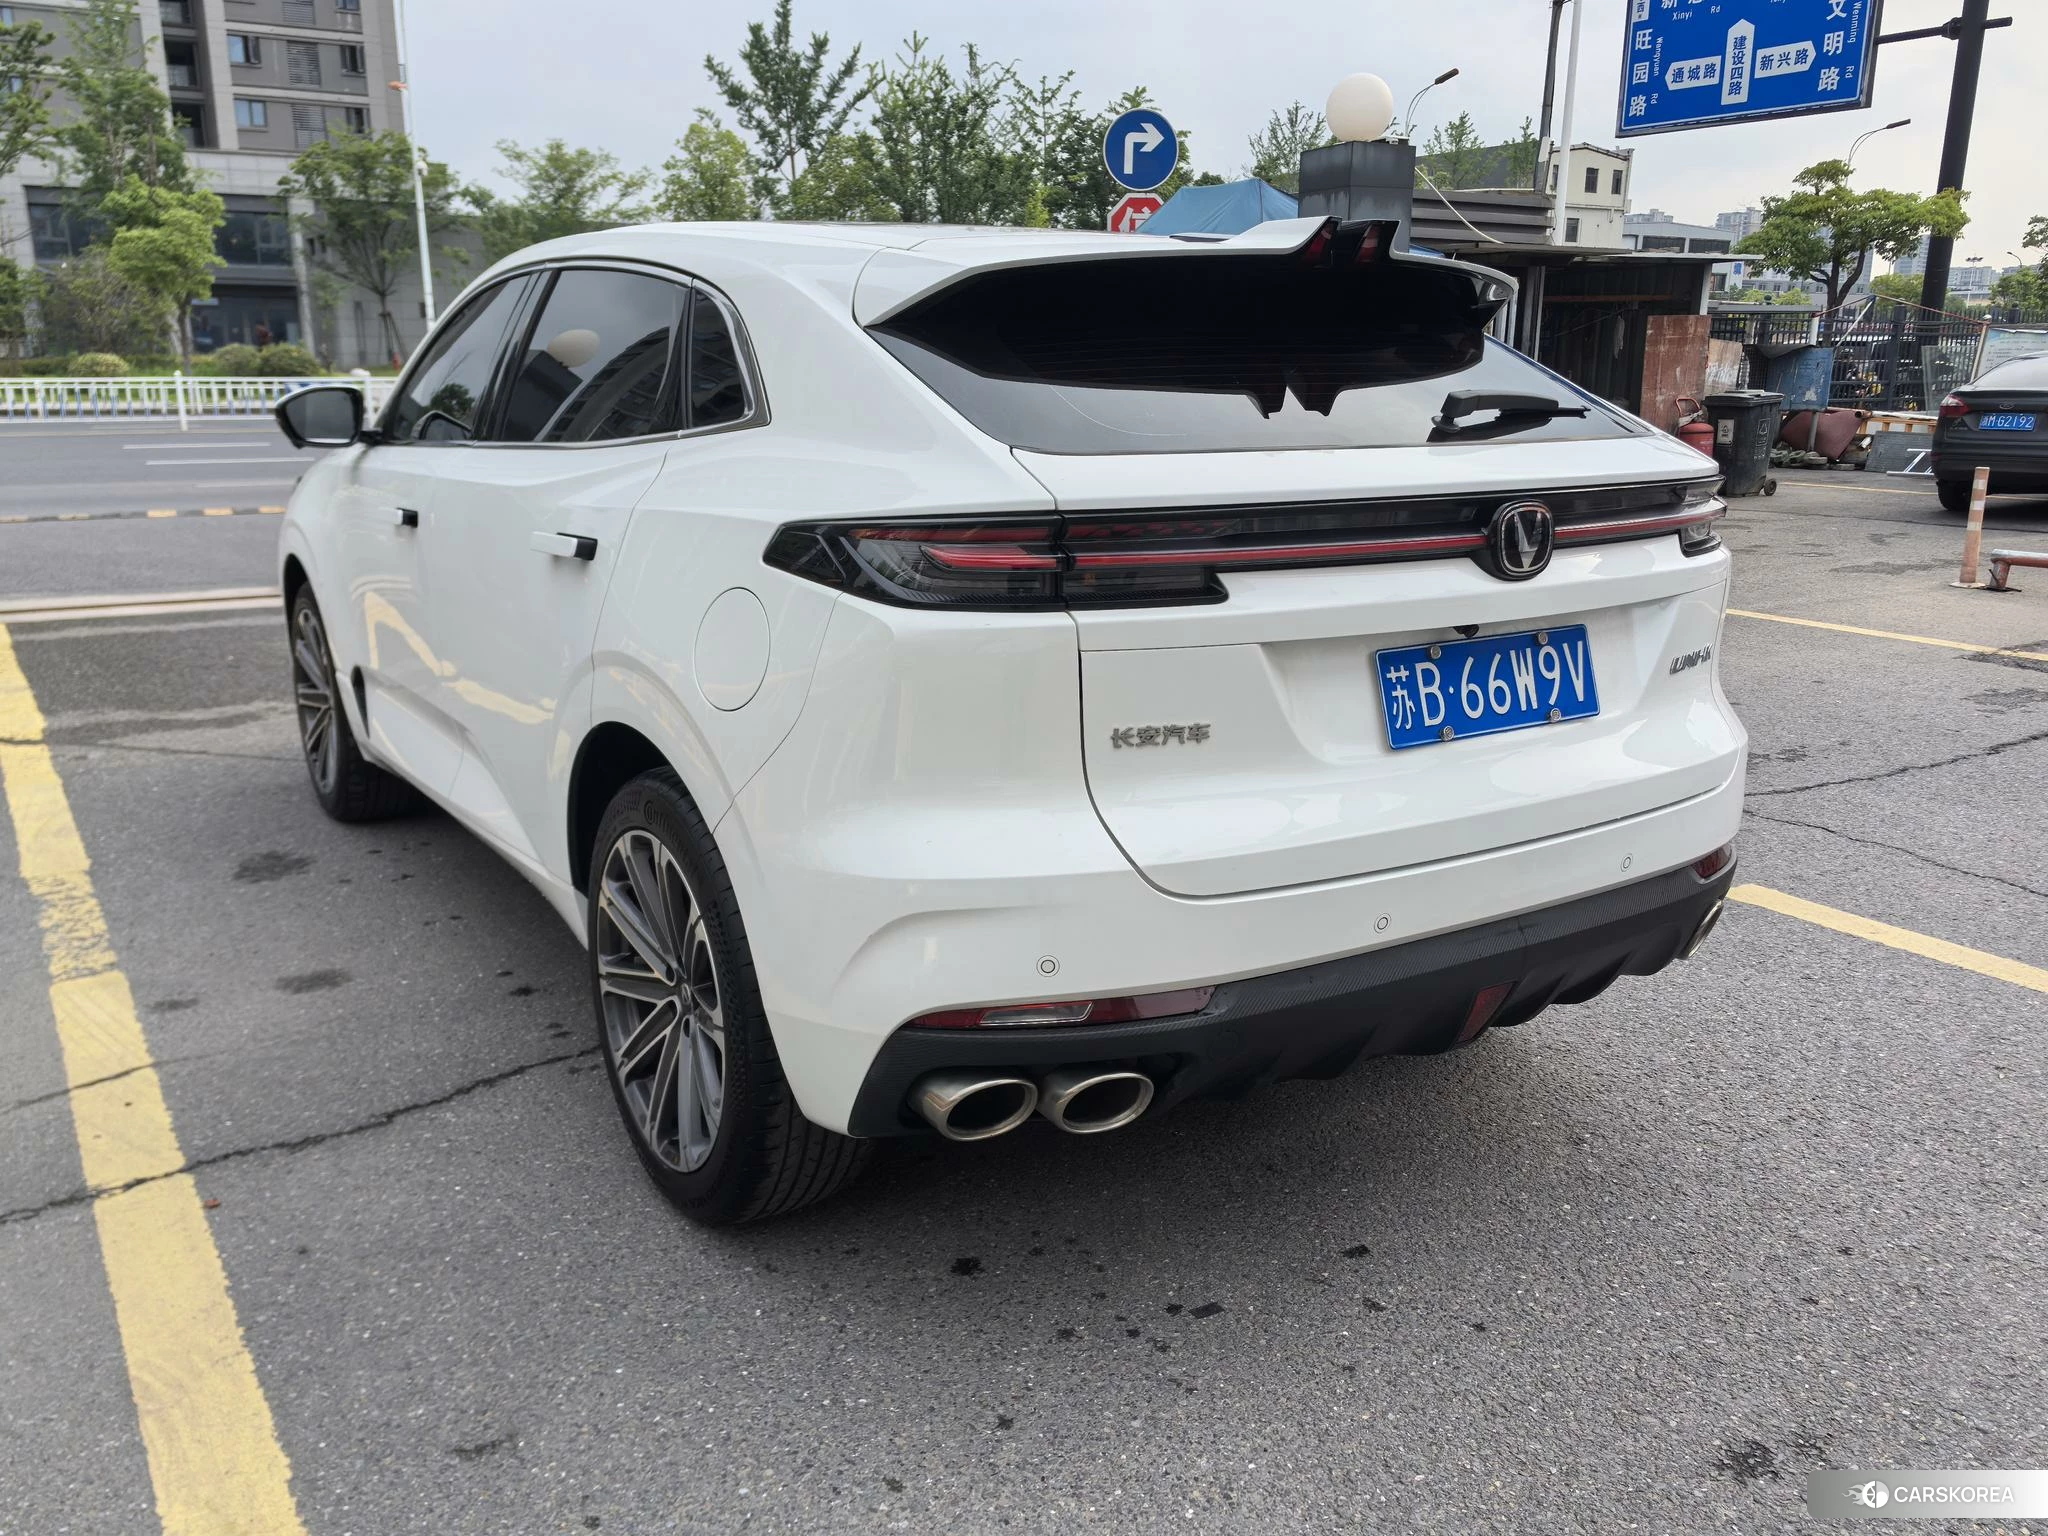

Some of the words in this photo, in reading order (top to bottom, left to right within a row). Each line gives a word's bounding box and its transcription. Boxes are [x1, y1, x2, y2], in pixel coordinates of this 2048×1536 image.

[1672, 9, 1694, 21] Xinyi
[1710, 5, 1721, 14] Rd
[1847, 1, 1862, 44] Wenming
[1653, 36, 1664, 77] Wangyuan
[1817, 0, 1847, 92] 文明路
[1728, 34, 1748, 97] 建设四路
[1759, 47, 1809, 72] 新兴路
[1845, 65, 1855, 79] Rd
[1628, 28, 1654, 118] 旺园路
[1671, 62, 1717, 84] 通城路
[1650, 92, 1659, 105] Rd
[1110, 723, 1211, 749] 长安汽车
